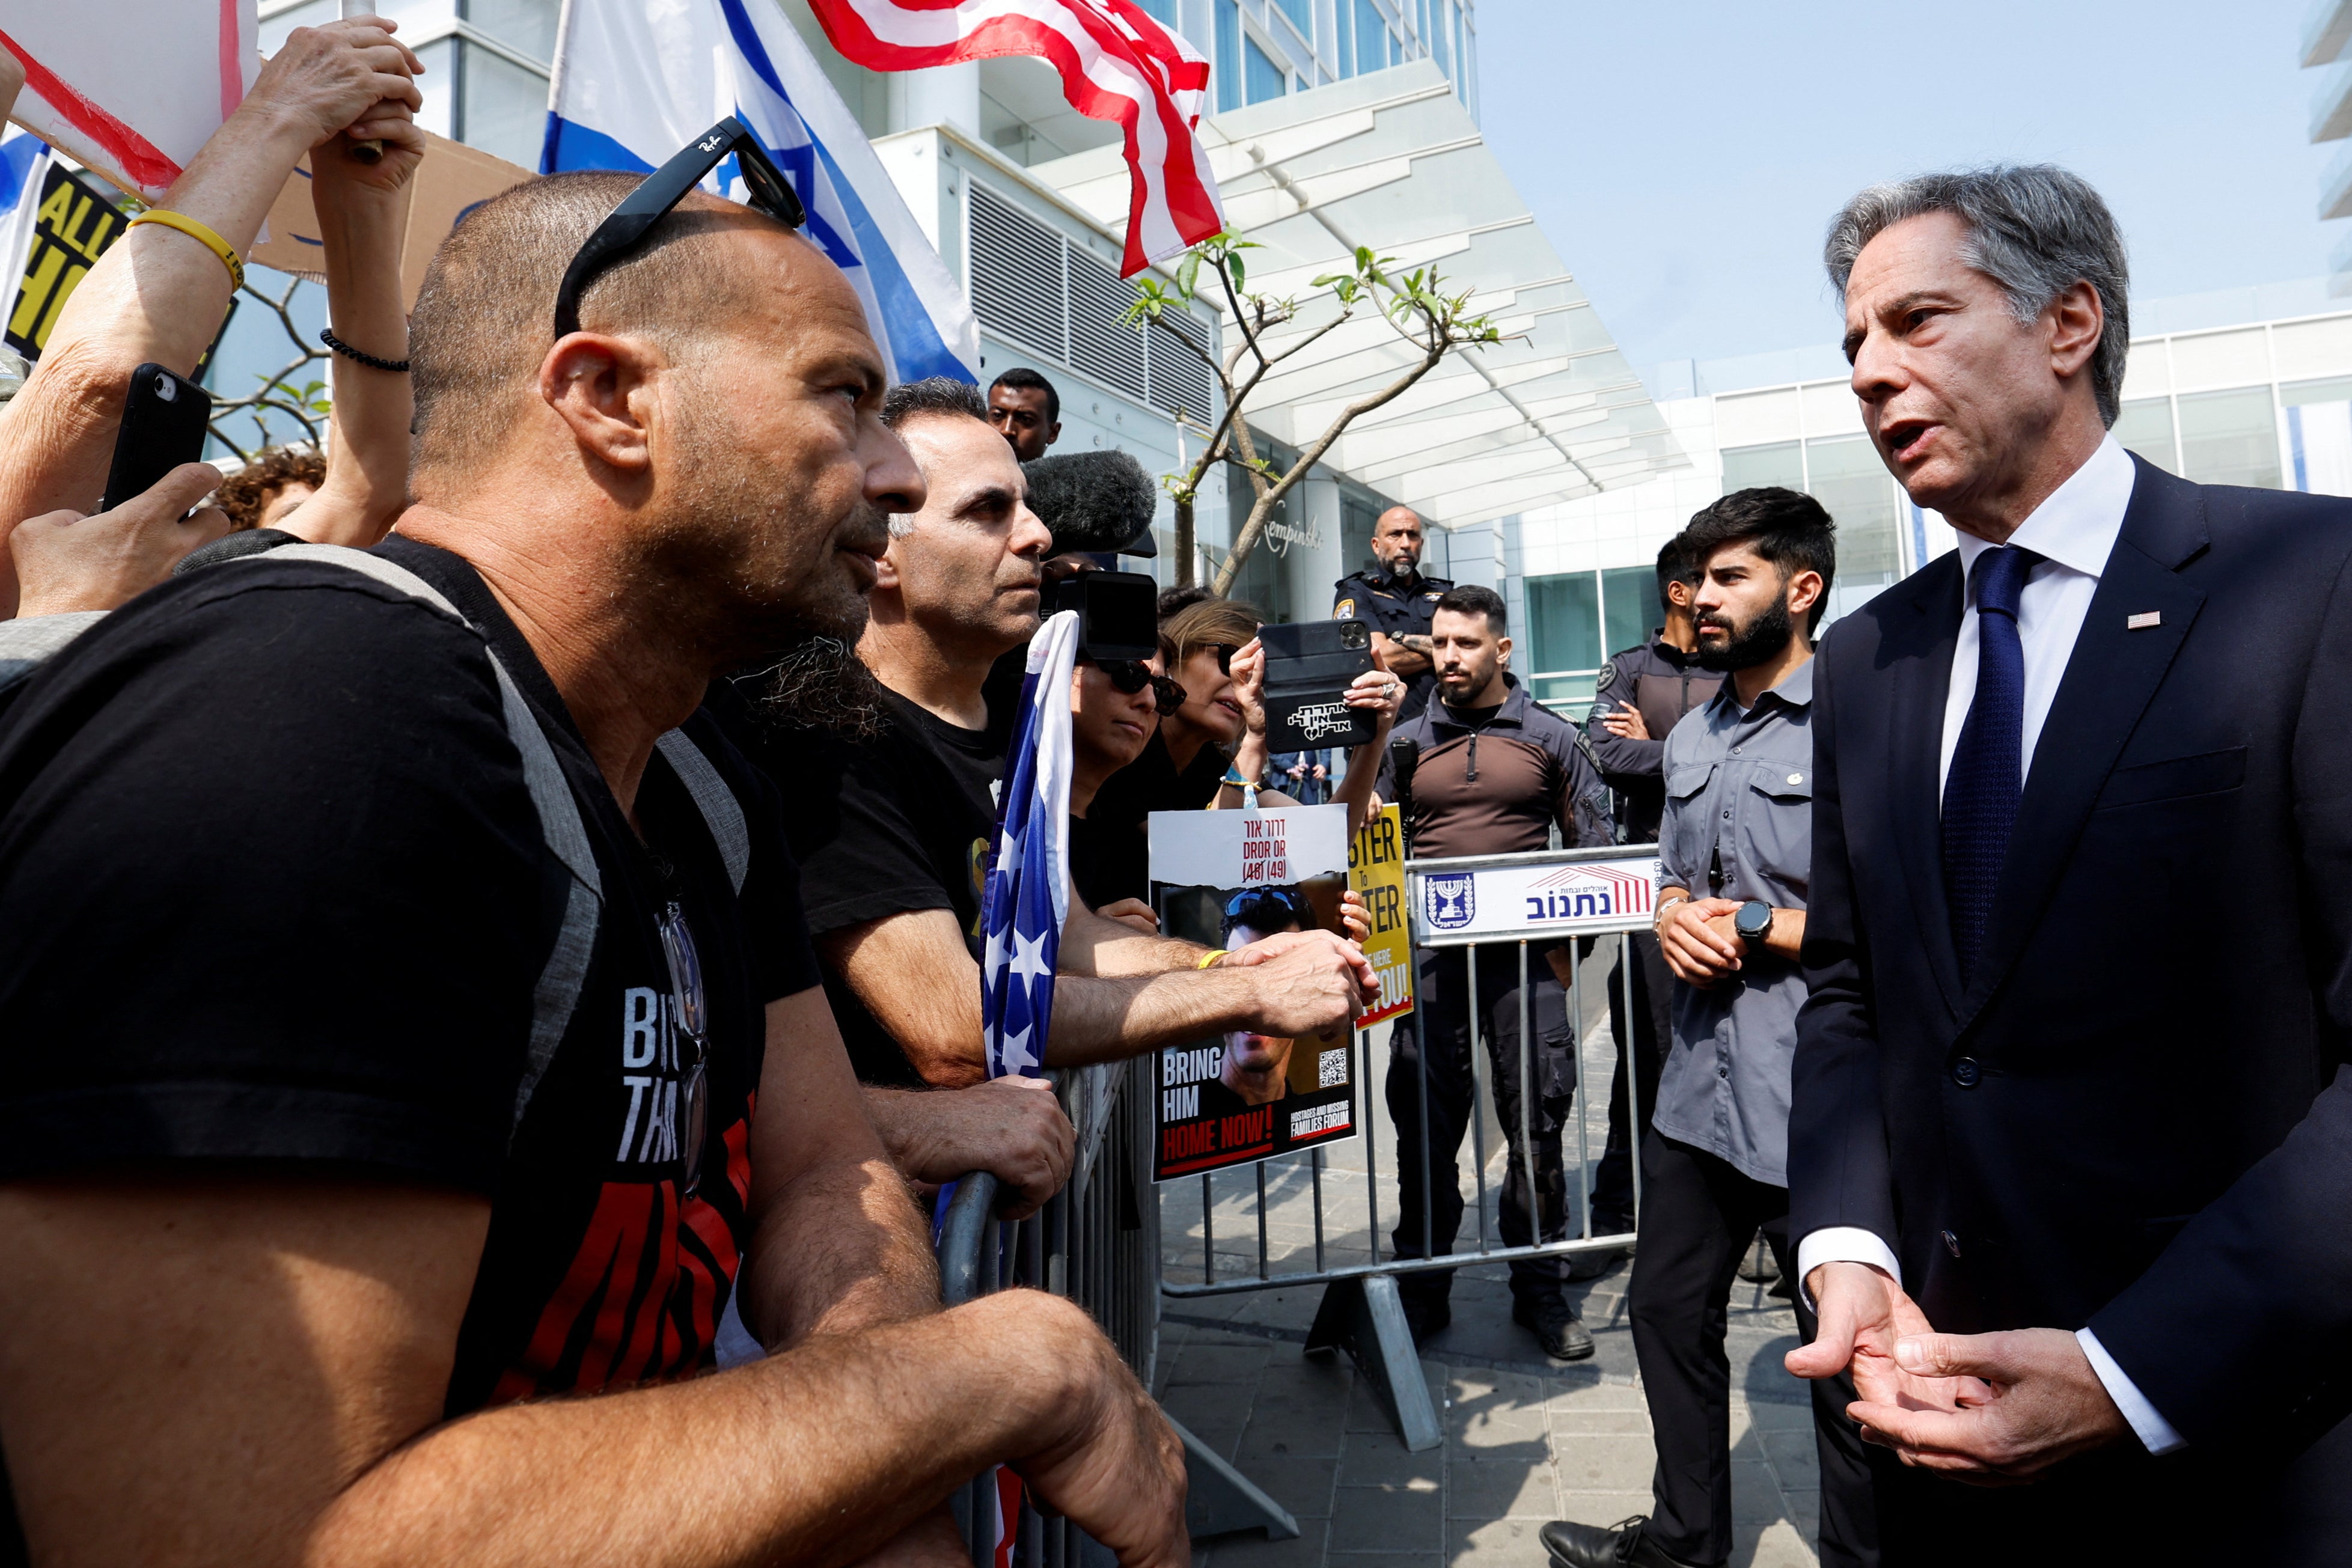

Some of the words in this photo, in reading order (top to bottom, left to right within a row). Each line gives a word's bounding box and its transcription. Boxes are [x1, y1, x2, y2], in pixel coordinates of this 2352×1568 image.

[1244, 820, 1262, 838] אור
[1265, 819, 1285, 837] דרור
[1243, 841, 1271, 859] DROR
[1274, 840, 1286, 857] OR
[1267, 859, 1286, 881] (49)
[1359, 870, 1367, 888] To
[1373, 948, 1392, 968] HERE
[1163, 1047, 1221, 1087] BRING
[1163, 1085, 1199, 1123] HIM
[1291, 1107, 1316, 1123] HOSTAGES
[1316, 1105, 1327, 1117] AND
[1327, 1100, 1349, 1114] MISSING
[1163, 1120, 1216, 1161] HOME
[1221, 1105, 1273, 1149] NOW!
[1291, 1116, 1322, 1138] FAMILIES
[1324, 1109, 1349, 1130] FORUM
